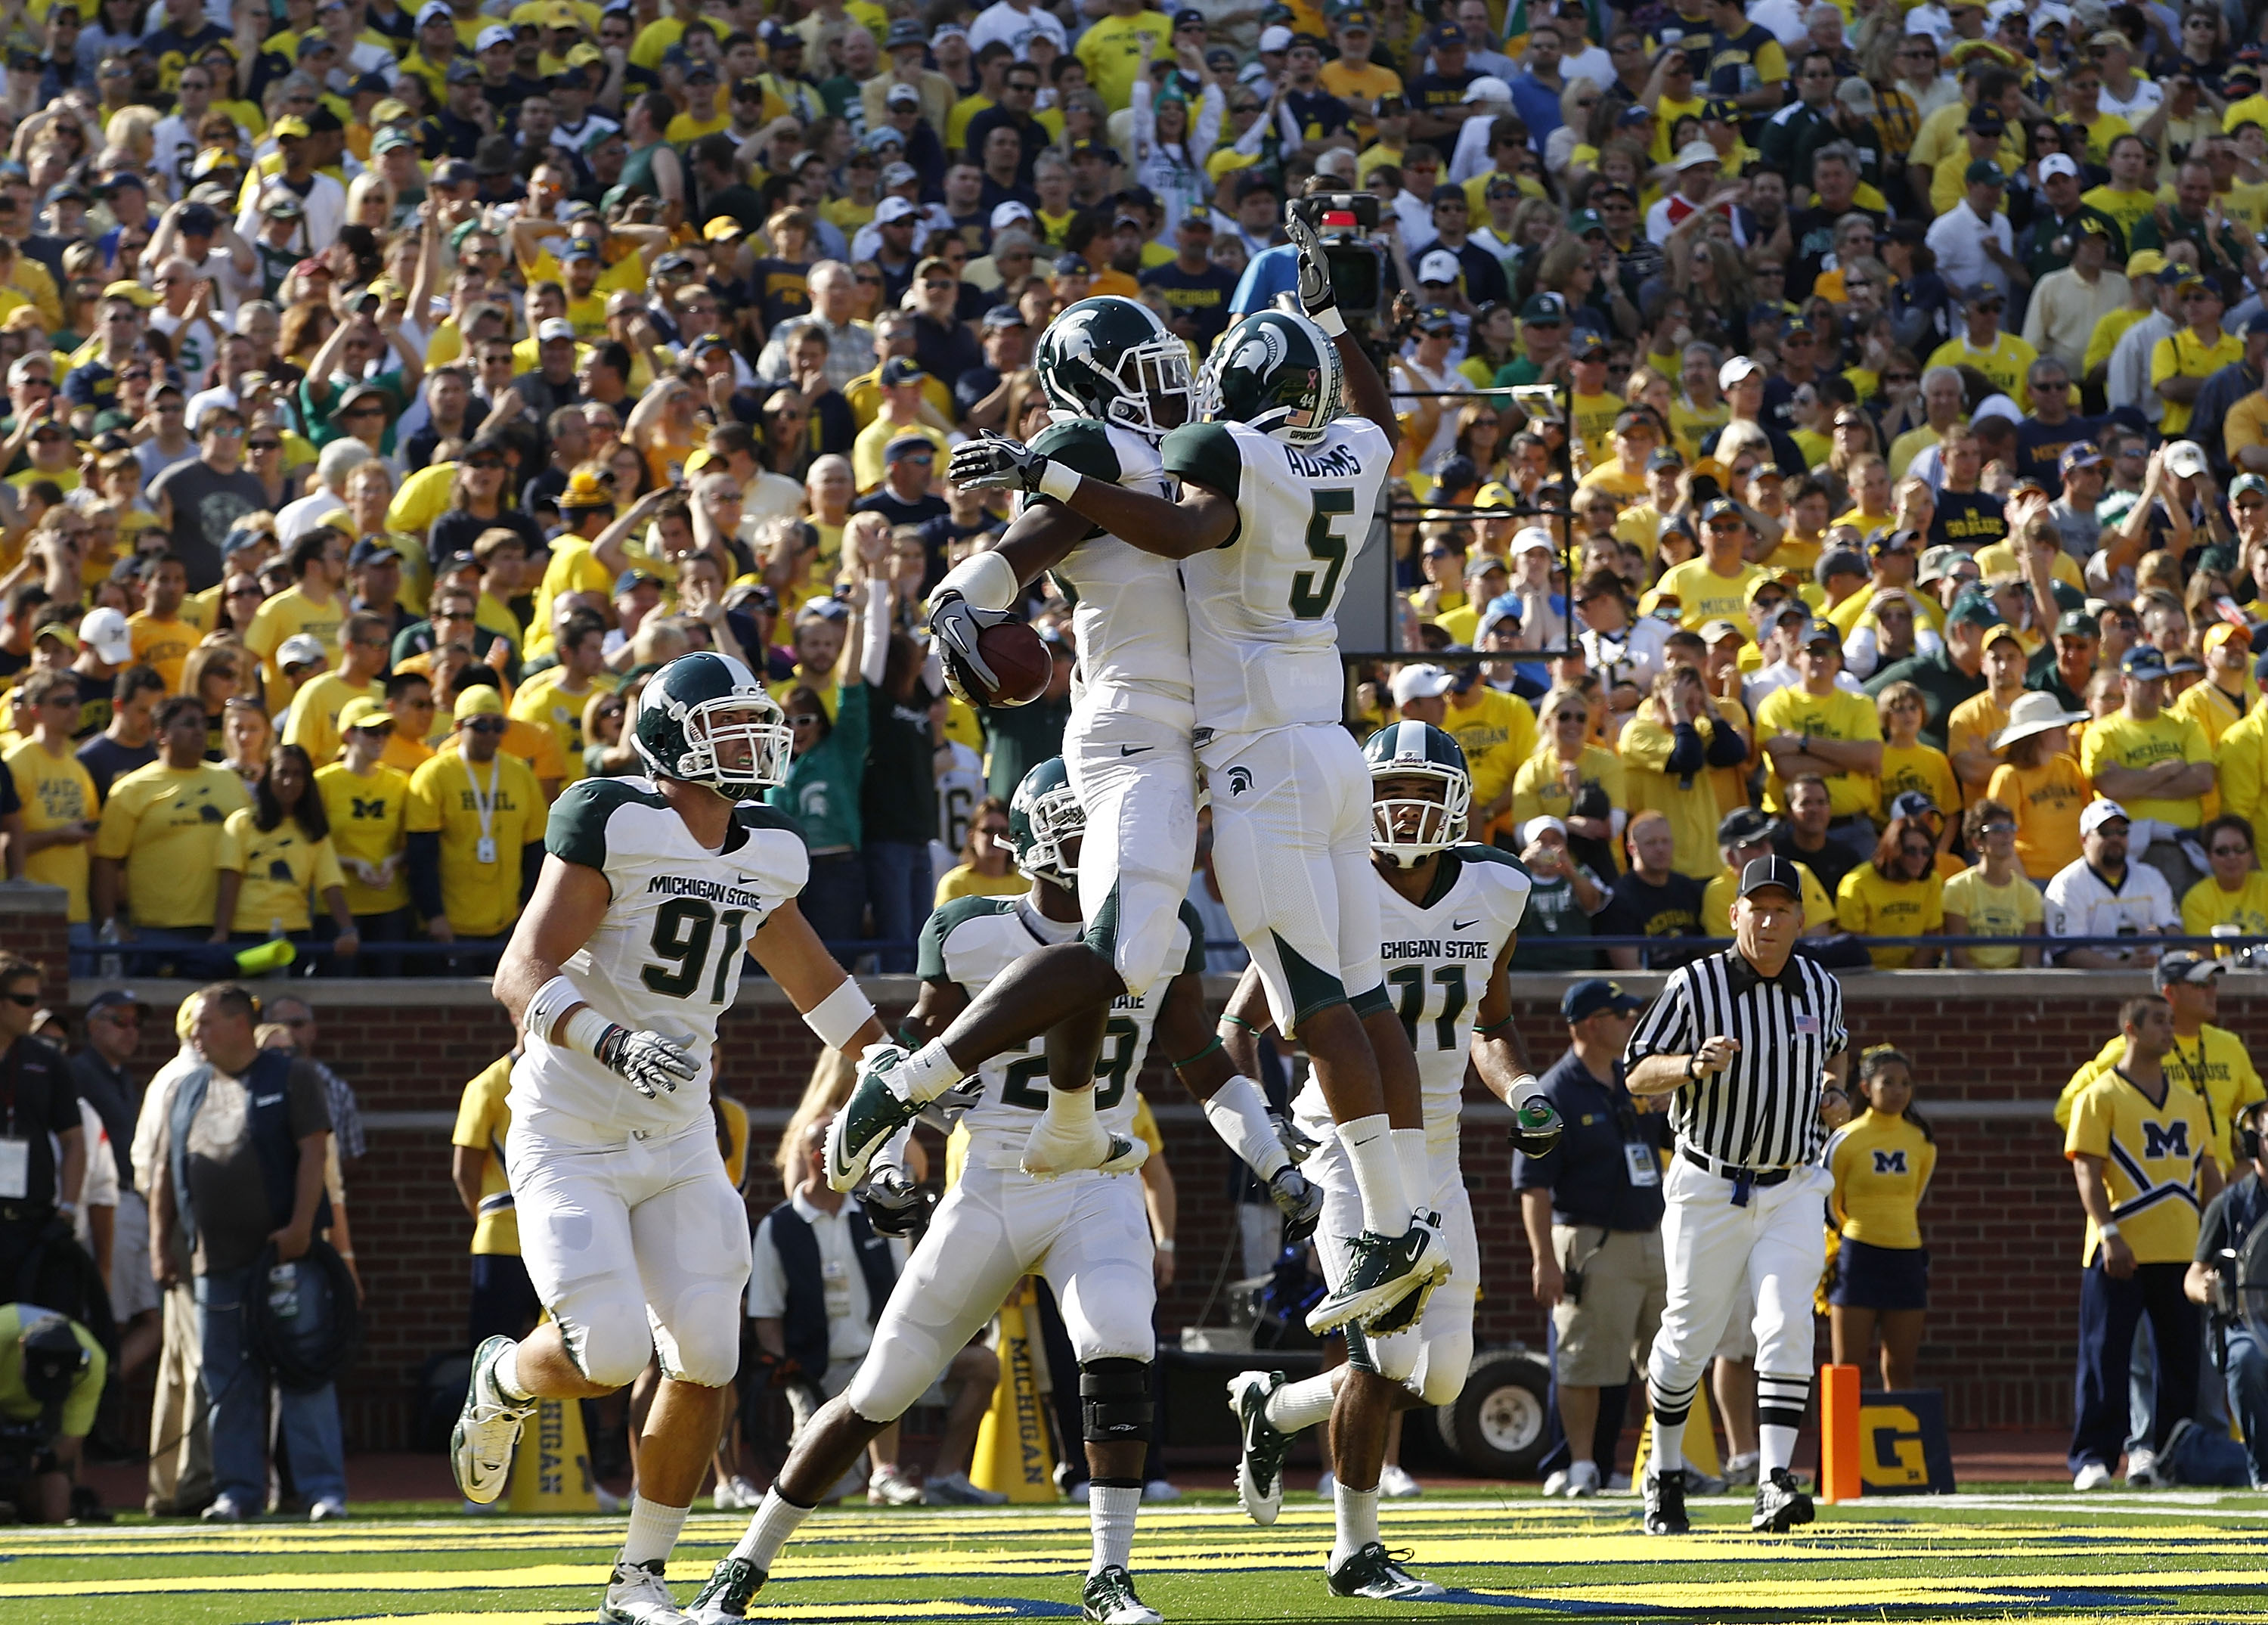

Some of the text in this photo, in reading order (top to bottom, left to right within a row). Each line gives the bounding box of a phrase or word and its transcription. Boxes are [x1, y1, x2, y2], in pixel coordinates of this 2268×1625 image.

[1300, 393, 1316, 408] 44
[1283, 445, 1362, 478] ADAMS
[1287, 488, 1356, 621] 5
[1699, 596, 1745, 616] MICHI
[352, 798, 386, 820] M
[647, 876, 762, 913] MICHIGAN STATE
[639, 898, 750, 1005] 91
[1381, 940, 1489, 959] CHIGAN STATE
[1387, 964, 1468, 1052] 11
[1001, 1016, 1139, 1111] 29
[2141, 1120, 2190, 1160] M
[1872, 1148, 1909, 1175] M
[1010, 1336, 1046, 1484] MICHIGAN
[539, 1399, 562, 1495] HIGAN
[1860, 1404, 1929, 1487] G
